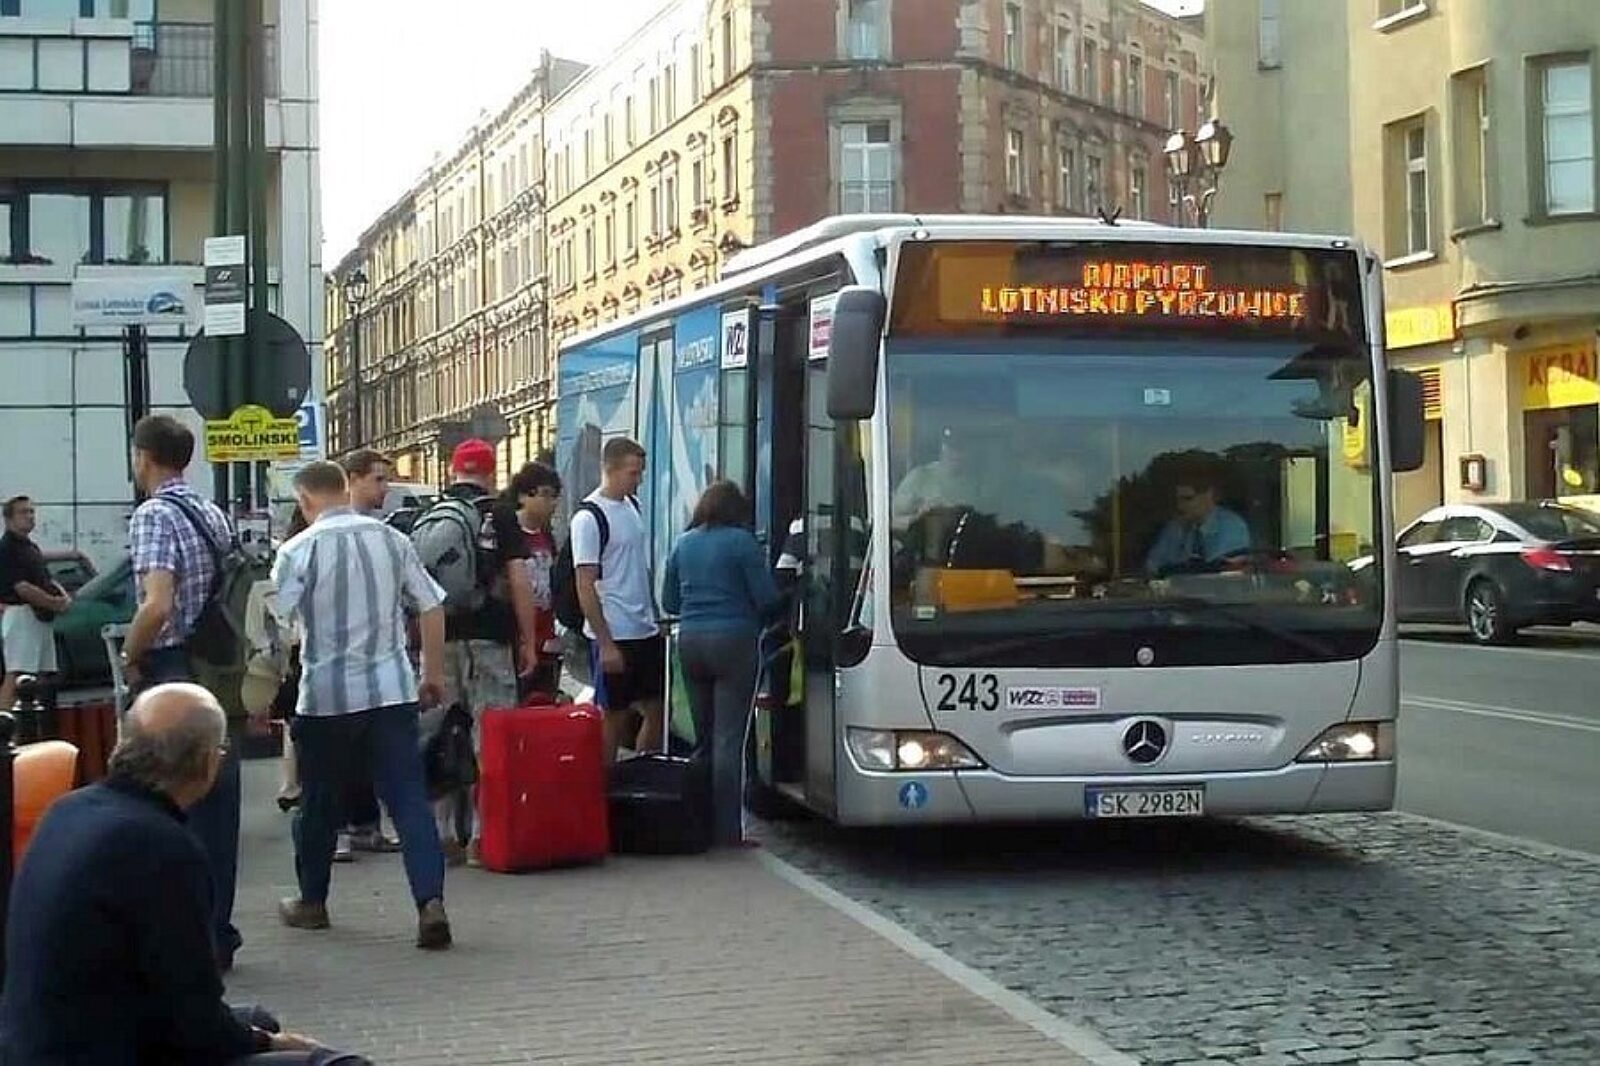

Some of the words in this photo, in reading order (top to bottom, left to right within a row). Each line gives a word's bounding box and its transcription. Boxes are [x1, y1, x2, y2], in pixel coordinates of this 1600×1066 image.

[1083, 262, 1207, 288] AIRPORT
[981, 287, 1128, 314] LOTNISKO
[1136, 290, 1305, 316] PYRZOWICE
[1528, 349, 1597, 386] KEBA
[937, 673, 1000, 711] 243
[1100, 795, 1130, 815] SK
[1138, 790, 1200, 813] 2982N
